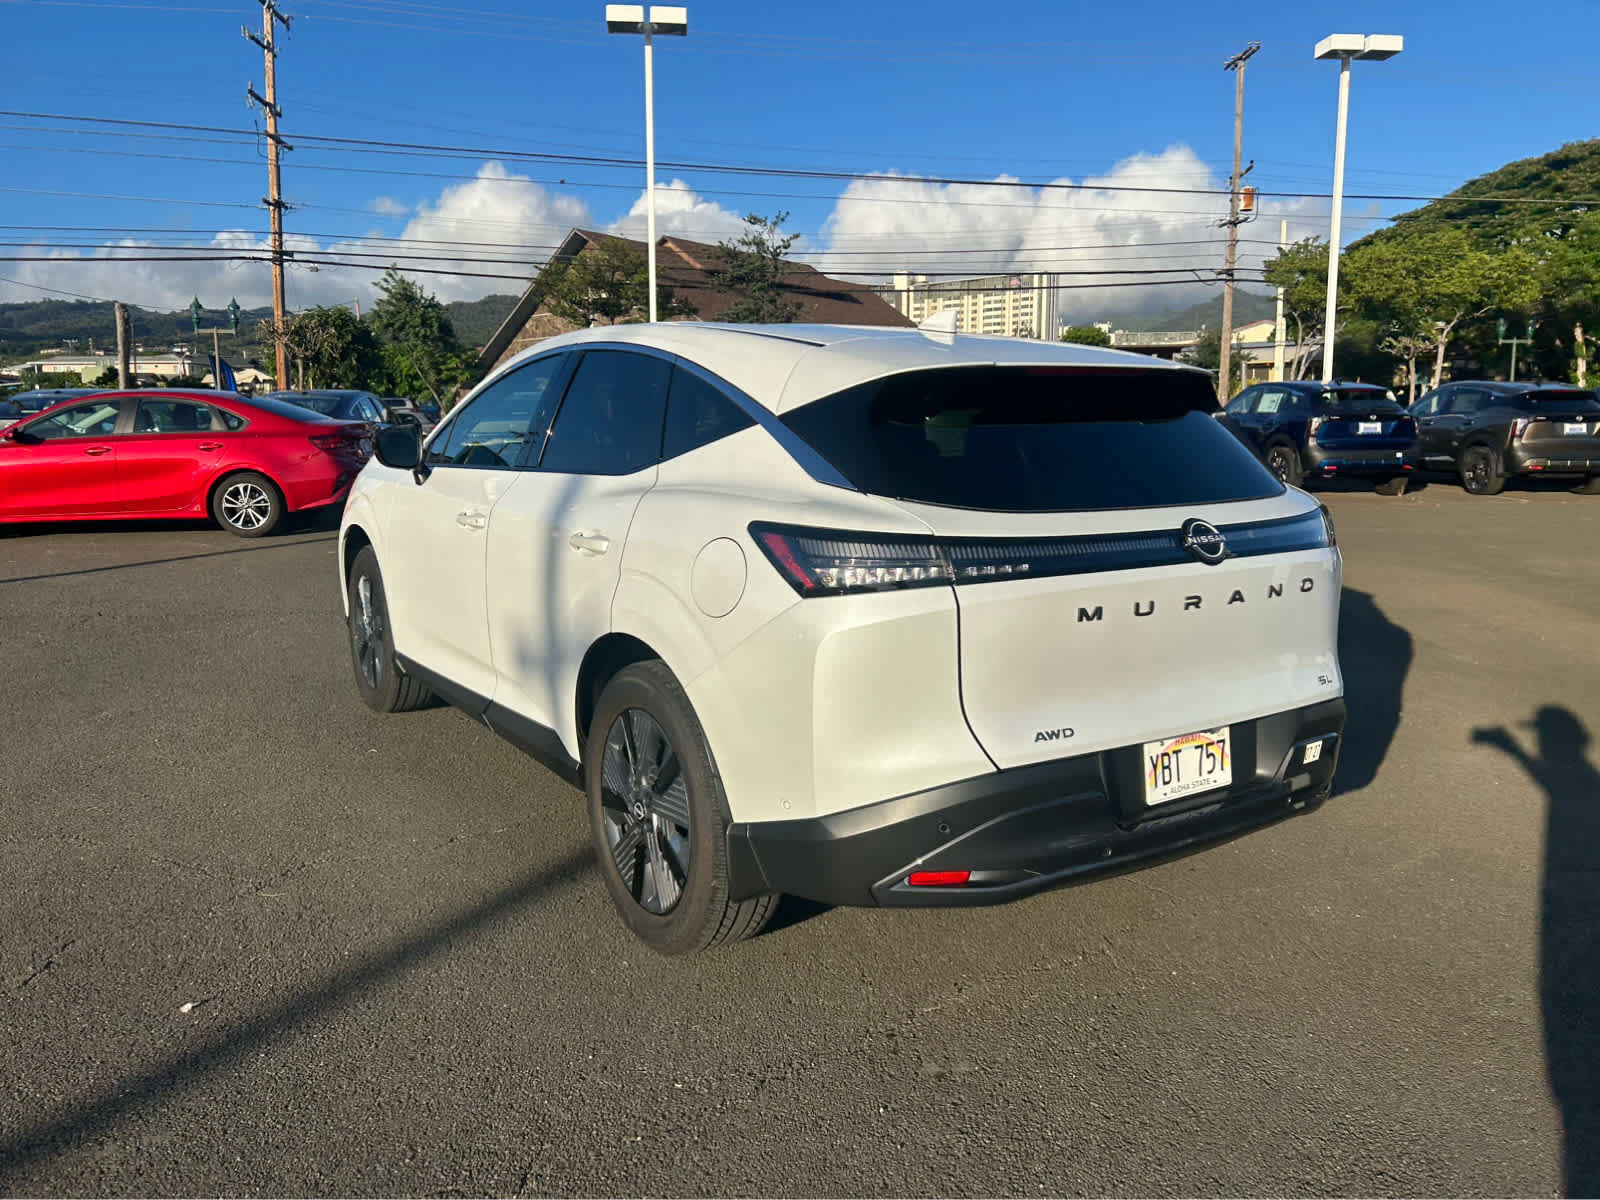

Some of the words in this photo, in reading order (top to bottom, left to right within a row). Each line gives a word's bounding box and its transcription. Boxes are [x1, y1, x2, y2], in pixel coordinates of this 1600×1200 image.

[1188, 534, 1226, 544] NISSAN
[1077, 577, 1315, 623] MURANO
[1317, 674, 1333, 686] SL
[1034, 727, 1075, 743] AWD
[1150, 749, 1182, 789] YBT
[1194, 738, 1226, 777] 757
[1169, 783, 1190, 794] ALOHA
[1191, 777, 1211, 790] STATE
